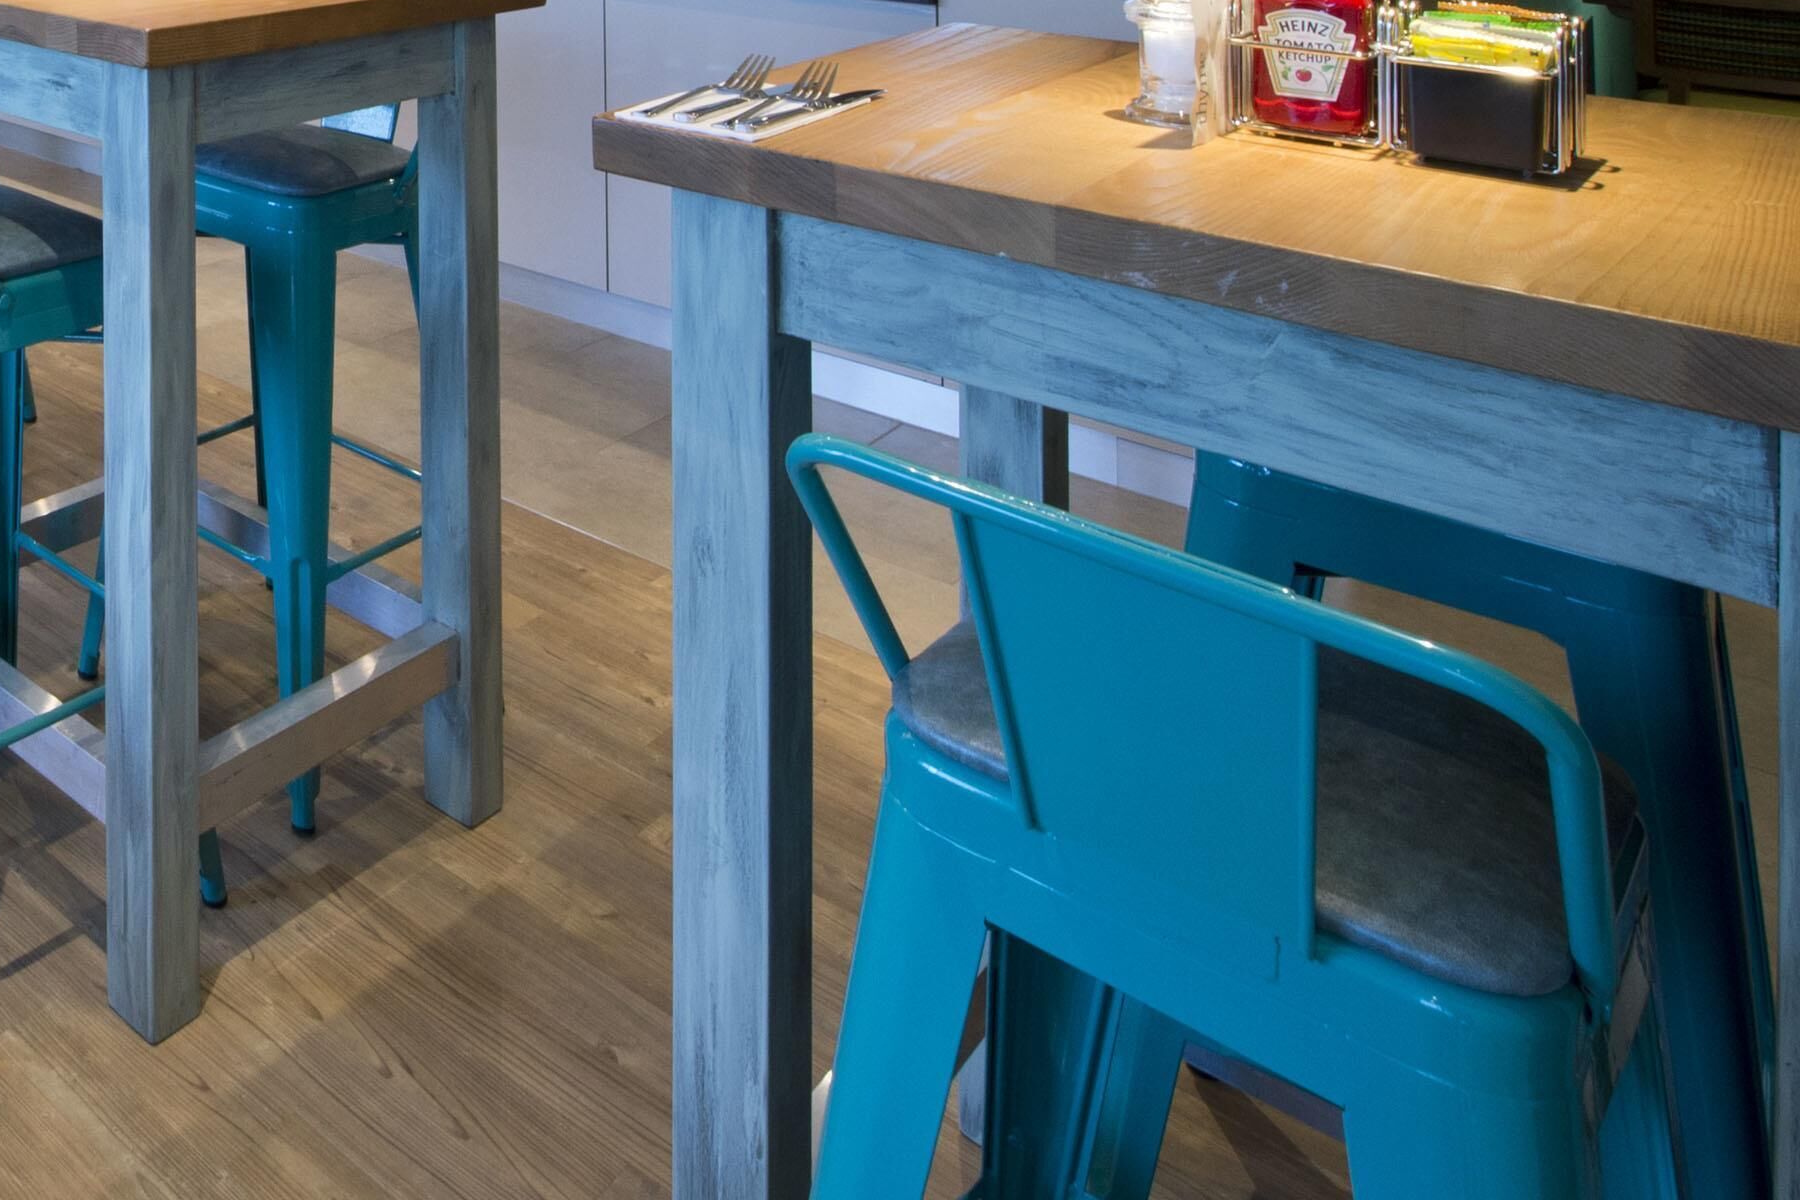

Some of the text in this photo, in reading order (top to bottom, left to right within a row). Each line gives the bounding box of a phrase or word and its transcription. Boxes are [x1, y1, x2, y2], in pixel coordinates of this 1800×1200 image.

[1278, 19, 1330, 37] HEINZ
[1274, 38, 1335, 52] TOMATO
[1278, 50, 1332, 64] KETCHUP
